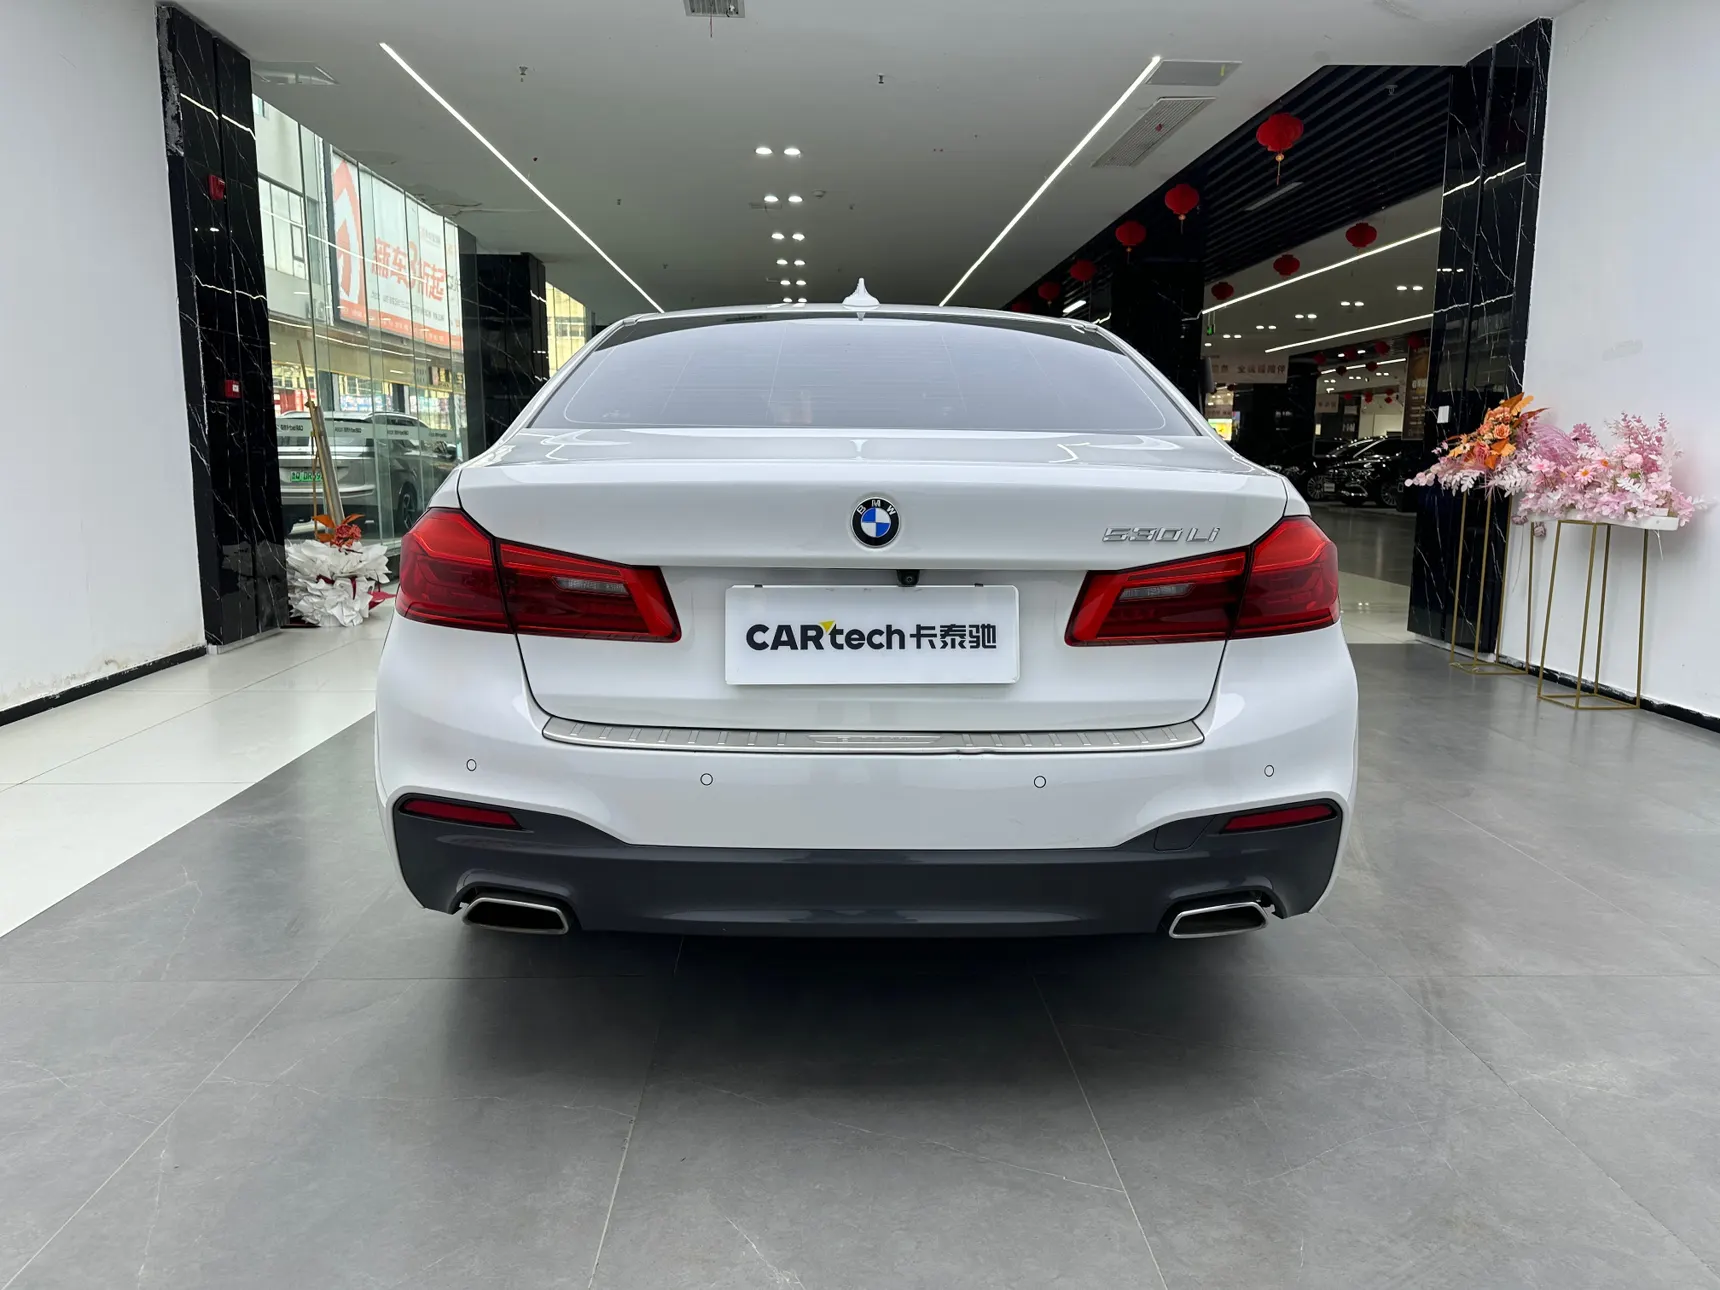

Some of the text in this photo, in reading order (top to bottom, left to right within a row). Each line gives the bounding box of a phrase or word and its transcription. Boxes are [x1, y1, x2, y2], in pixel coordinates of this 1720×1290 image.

[856, 499, 897, 516] BMW
[746, 622, 997, 651] CARtech 卡泰驰
